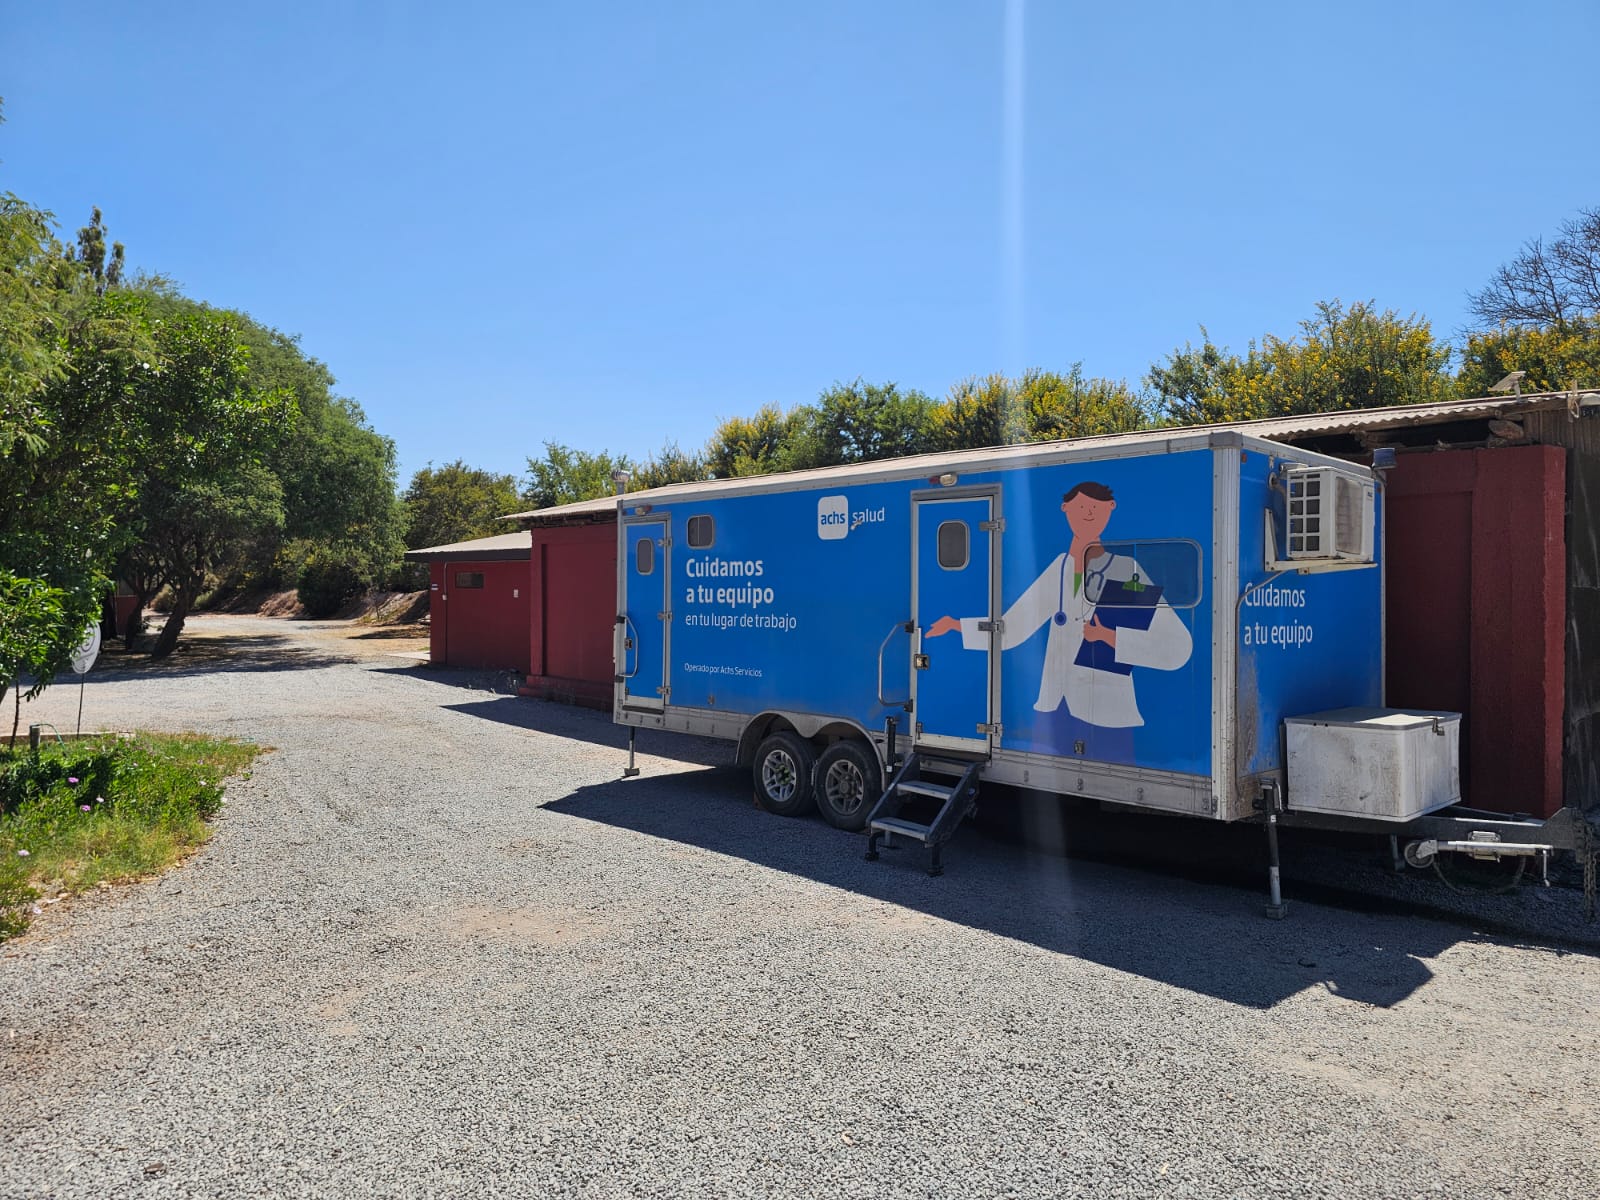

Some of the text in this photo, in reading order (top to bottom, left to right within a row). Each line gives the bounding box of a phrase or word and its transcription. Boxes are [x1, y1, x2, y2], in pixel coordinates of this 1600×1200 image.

[820, 506, 885, 525] achs salud
[686, 556, 764, 577] Cuidamos
[686, 581, 774, 608] a tu equipo
[1244, 582, 1306, 607] Cuidamos
[685, 612, 797, 632] en tu lugar de trabajo
[1244, 619, 1313, 649] a tu equipo
[684, 662, 709, 673] Operado
[709, 666, 720, 675] por
[734, 666, 763, 677] Servicios
